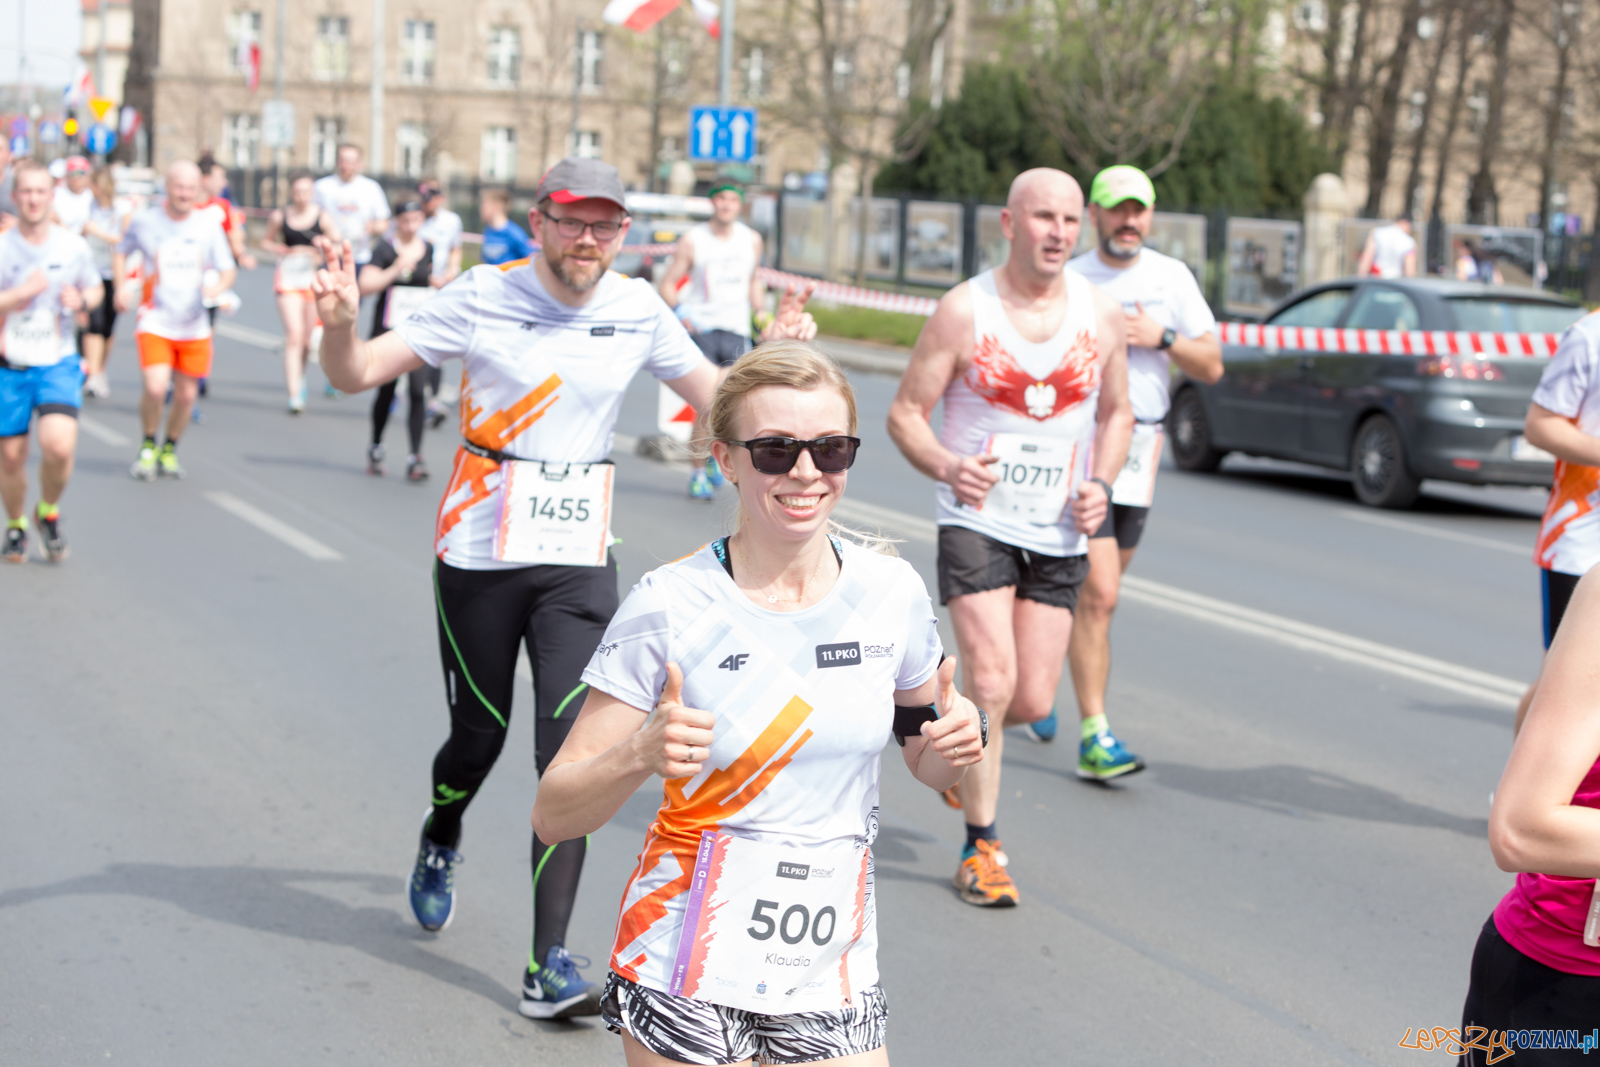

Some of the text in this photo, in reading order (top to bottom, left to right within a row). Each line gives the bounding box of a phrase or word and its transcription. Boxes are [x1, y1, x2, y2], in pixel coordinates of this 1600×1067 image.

[1002, 463, 1063, 487] 10717
[528, 496, 590, 521] 1455
[718, 653, 750, 671] 4F
[747, 899, 836, 946] 500
[765, 952, 811, 967] Klaudia
